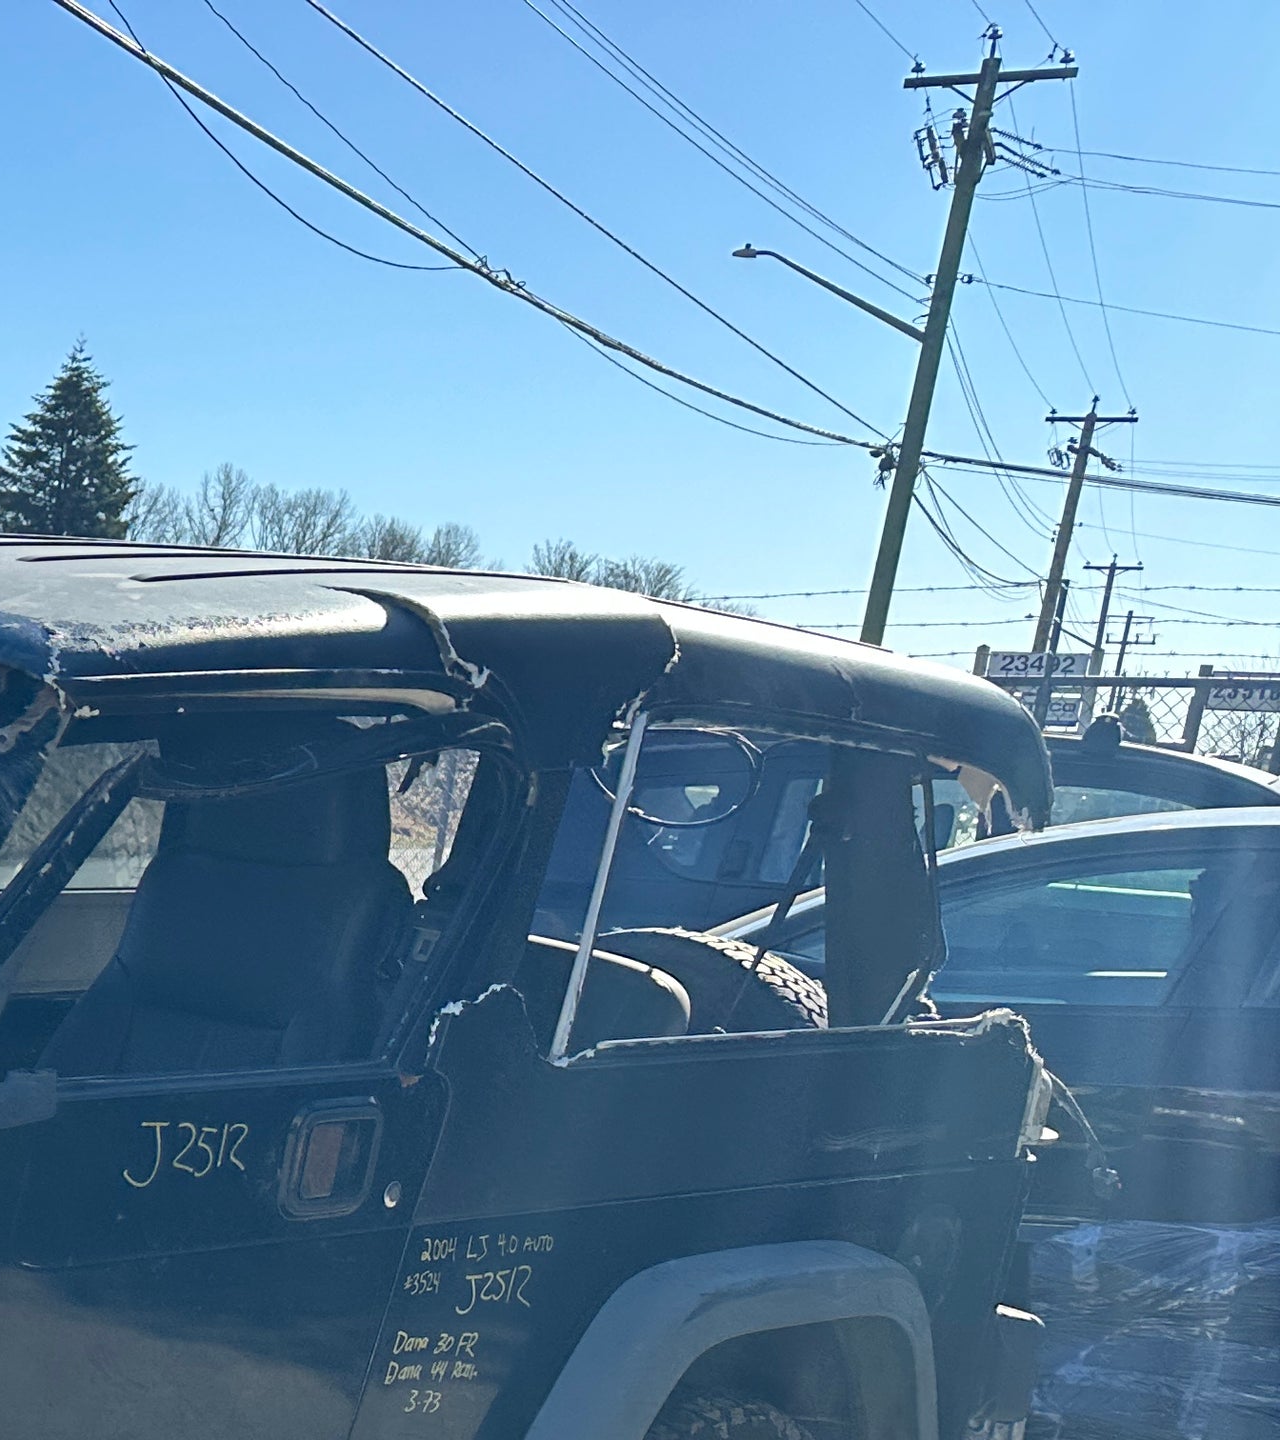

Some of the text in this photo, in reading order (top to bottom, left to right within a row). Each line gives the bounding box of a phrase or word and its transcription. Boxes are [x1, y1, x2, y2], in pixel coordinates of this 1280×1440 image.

[123, 1122, 249, 1188] J2512
[421, 1232, 554, 1262] 2004 LJ 4.0 AUTO
[455, 1265, 532, 1315] J2512
[392, 1330, 479, 1358] Dana 30 FR
[384, 1361, 423, 1385] Dana
[430, 1359, 449, 1383] 44
